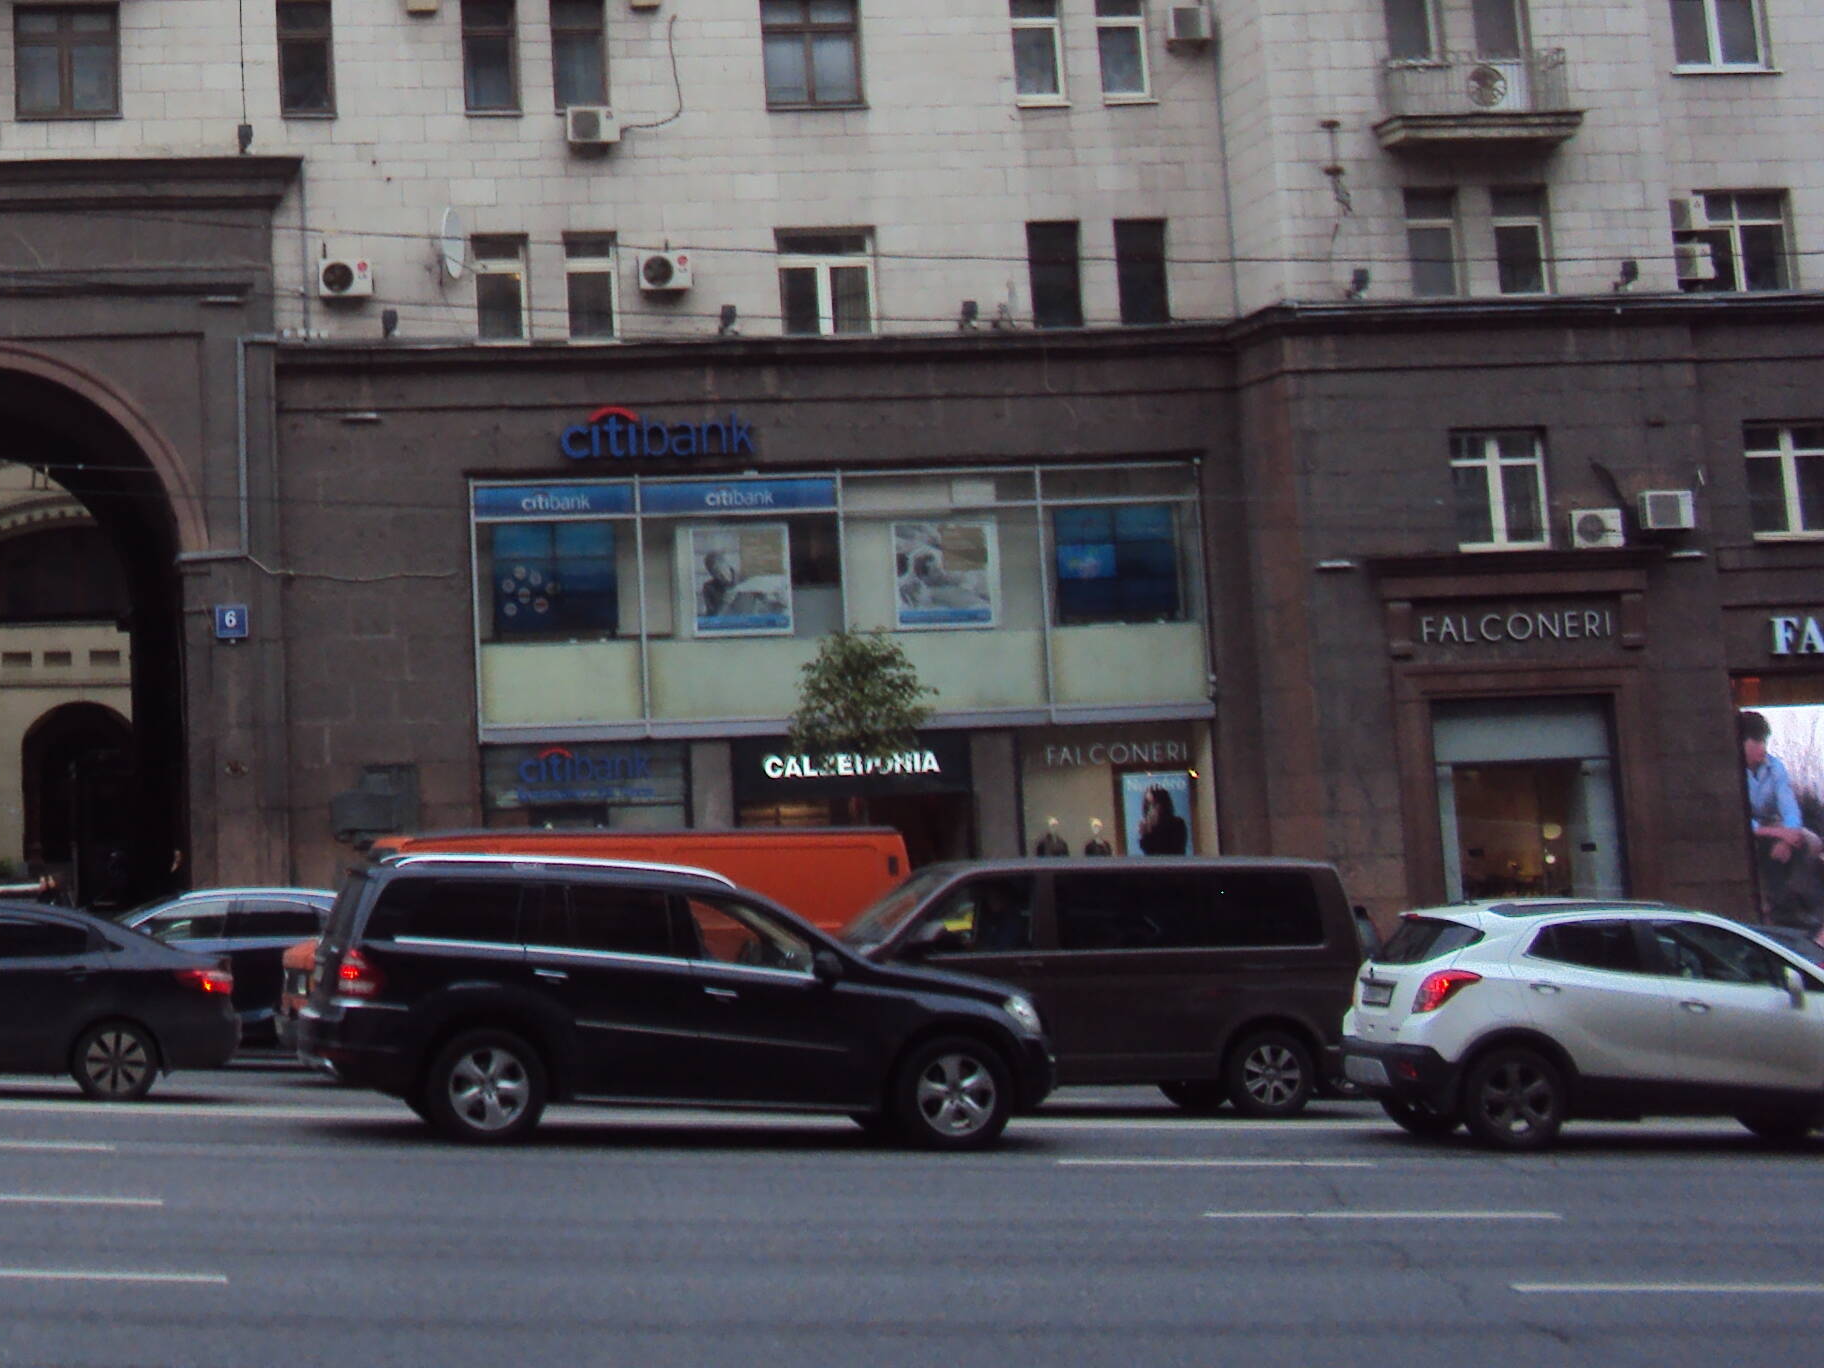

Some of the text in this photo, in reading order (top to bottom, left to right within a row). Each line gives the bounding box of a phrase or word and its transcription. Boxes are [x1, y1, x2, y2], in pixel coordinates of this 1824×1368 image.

[560, 407, 757, 459] citibank
[521, 491, 591, 512] citibank
[705, 488, 775, 507] citibank
[225, 610, 237, 628] 6
[1420, 610, 1611, 643] FALCONERI
[517, 747, 652, 783] citibank
[1044, 741, 1188, 766] FALCONERI
